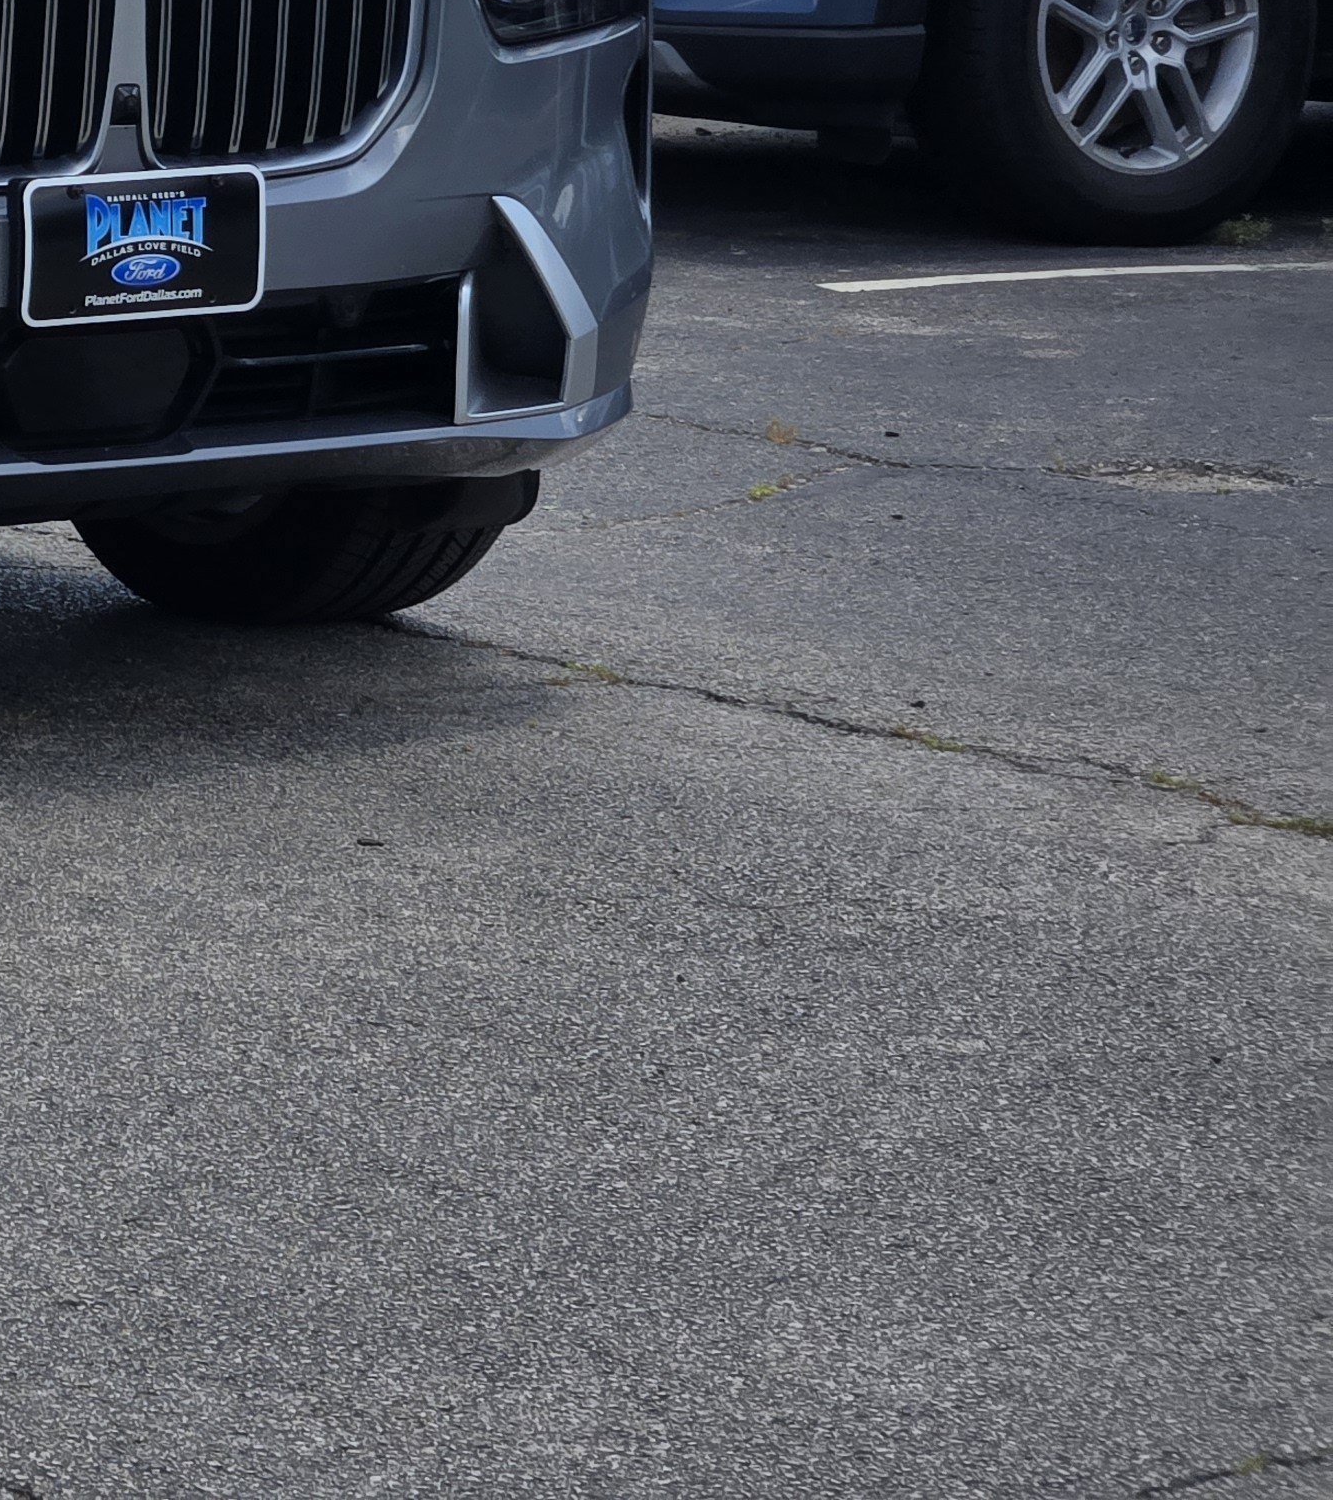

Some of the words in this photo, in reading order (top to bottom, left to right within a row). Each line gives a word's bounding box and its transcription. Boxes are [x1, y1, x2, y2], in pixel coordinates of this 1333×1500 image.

[85, 194, 207, 257] PLANET
[91, 244, 135, 267] DALLAS
[138, 242, 167, 251] LOVE
[171, 243, 201, 258] FIELD
[123, 258, 167, 281] Ford
[84, 288, 203, 307] PlanetFordDallas.com
